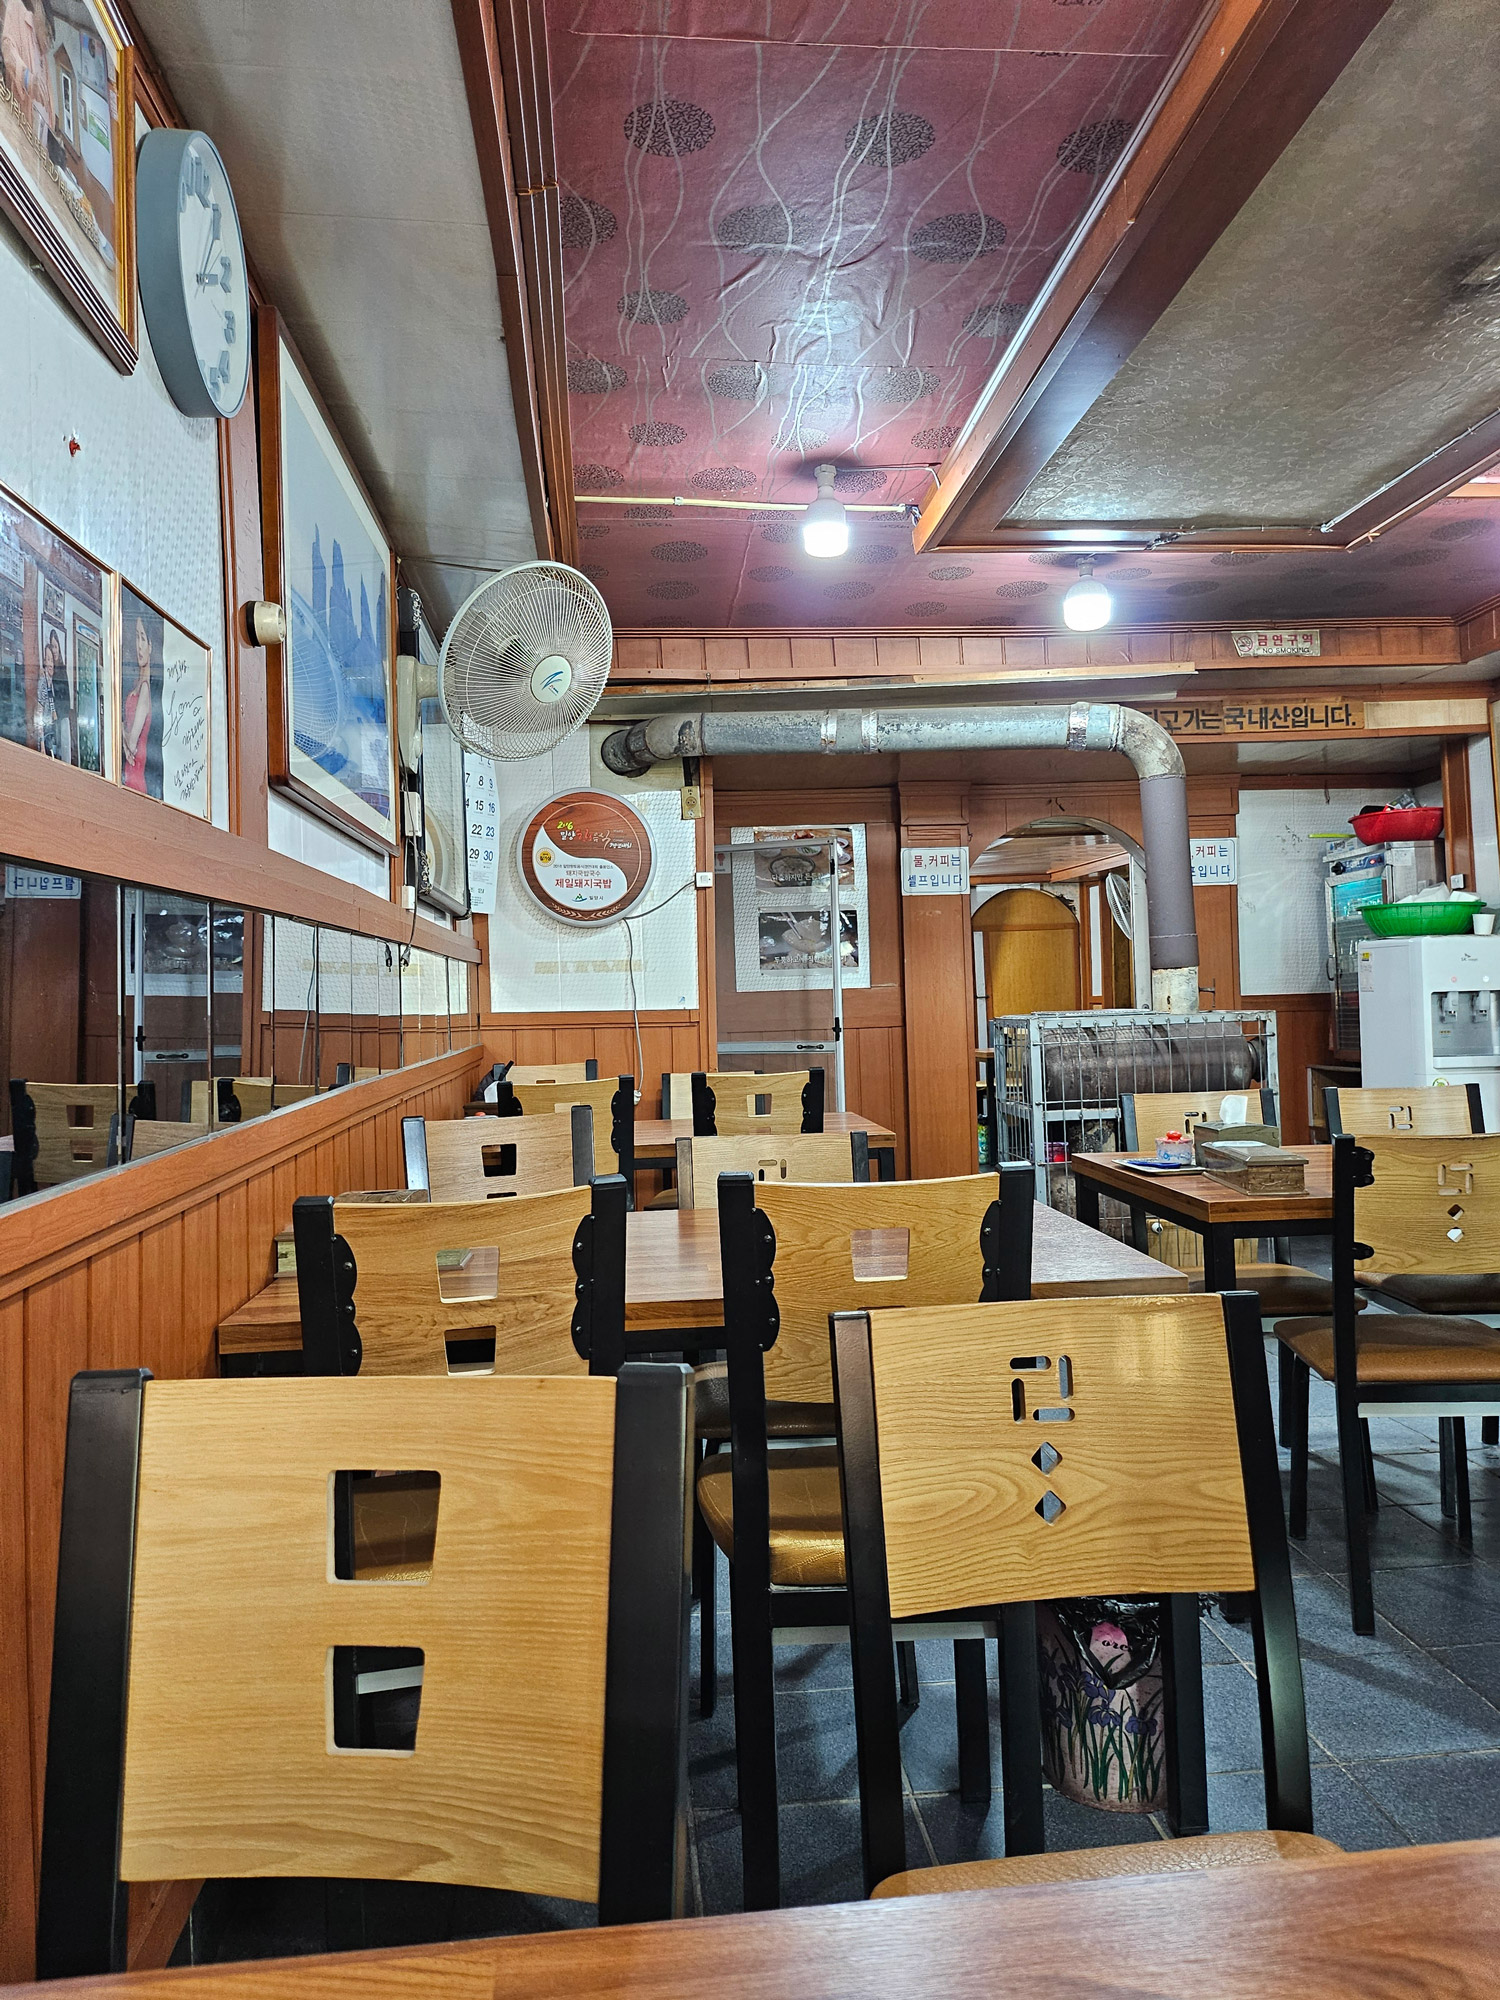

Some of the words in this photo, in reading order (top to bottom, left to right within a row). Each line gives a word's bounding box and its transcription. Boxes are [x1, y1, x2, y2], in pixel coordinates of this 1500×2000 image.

[1258, 633, 1314, 647] 금연구역
[465, 773, 471, 783] 7
[478, 776, 484, 786] 8
[488, 778, 494, 789] 9
[475, 799, 484, 811] 15
[488, 802, 496, 813] 16
[471, 823, 483, 836] 22
[485, 826, 495, 838] 23
[469, 848, 480, 860] 29
[483, 850, 494, 862] 30
[913, 853, 962, 869] 물,커피는
[554, 878, 612, 889] 제일돼지국밥
[907, 873, 963, 888] 셀프입니다
